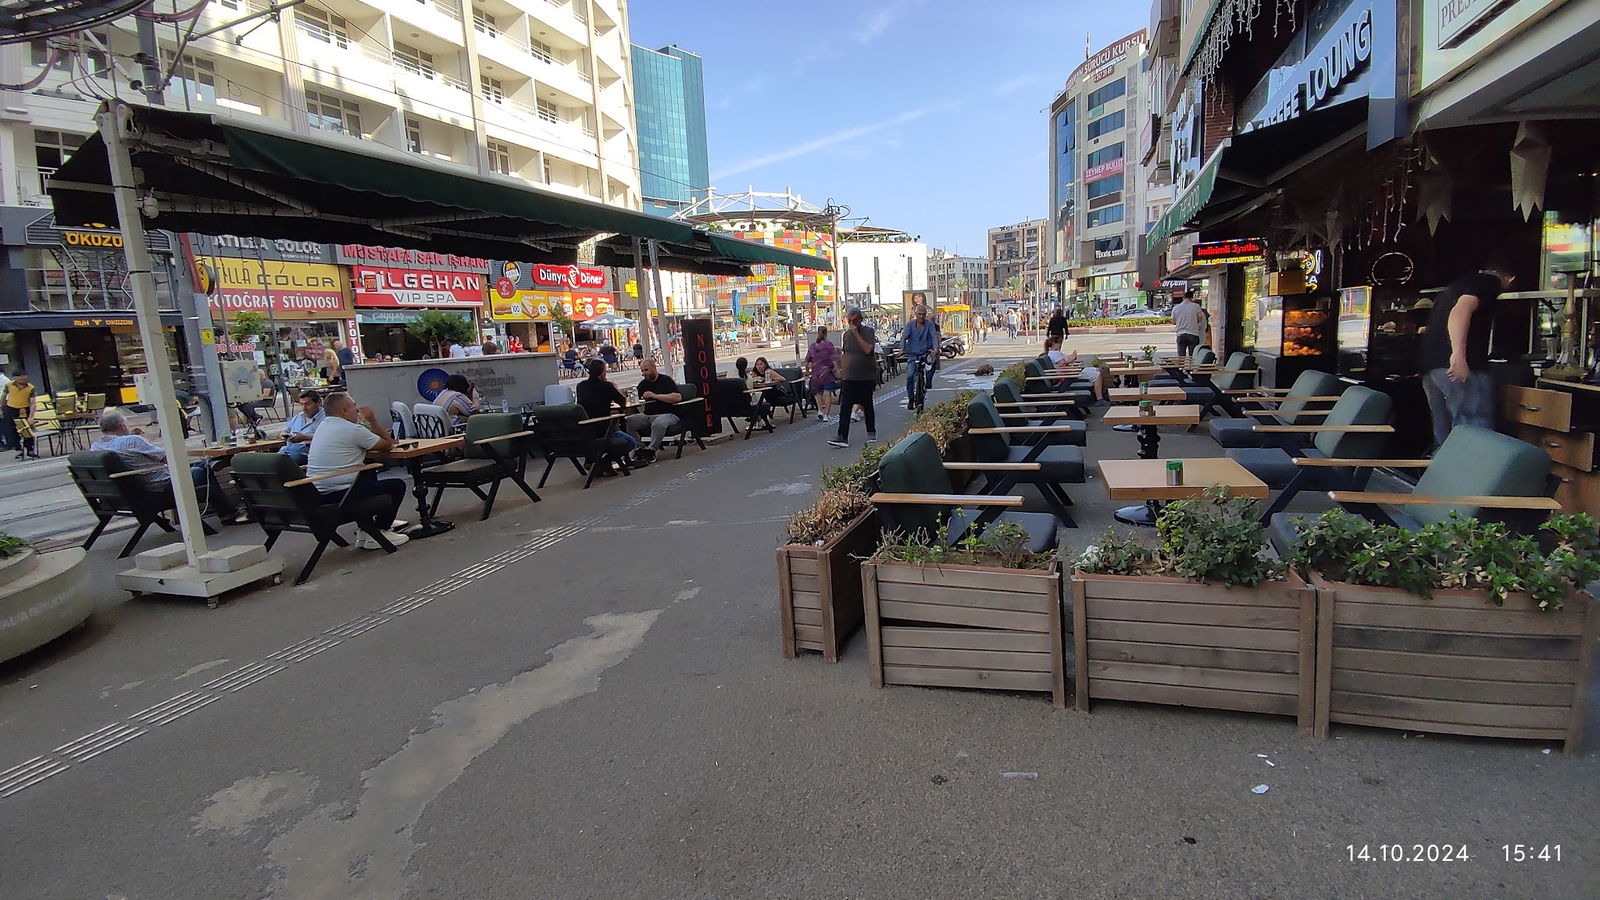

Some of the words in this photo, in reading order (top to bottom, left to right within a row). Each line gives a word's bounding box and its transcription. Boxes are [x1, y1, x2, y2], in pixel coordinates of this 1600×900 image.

[1441, 0, 1477, 29] PRES
[1112, 33, 1144, 58] KURSU
[274, 239, 321, 254] COLOR
[256, 273, 336, 288] COLOR
[539, 268, 567, 285] Dünya
[580, 271, 603, 285] Döner
[207, 291, 276, 309] FOTOĞRAF
[282, 292, 339, 309] STÜDYOSU
[394, 292, 420, 303] VIP
[426, 294, 456, 304] SPA
